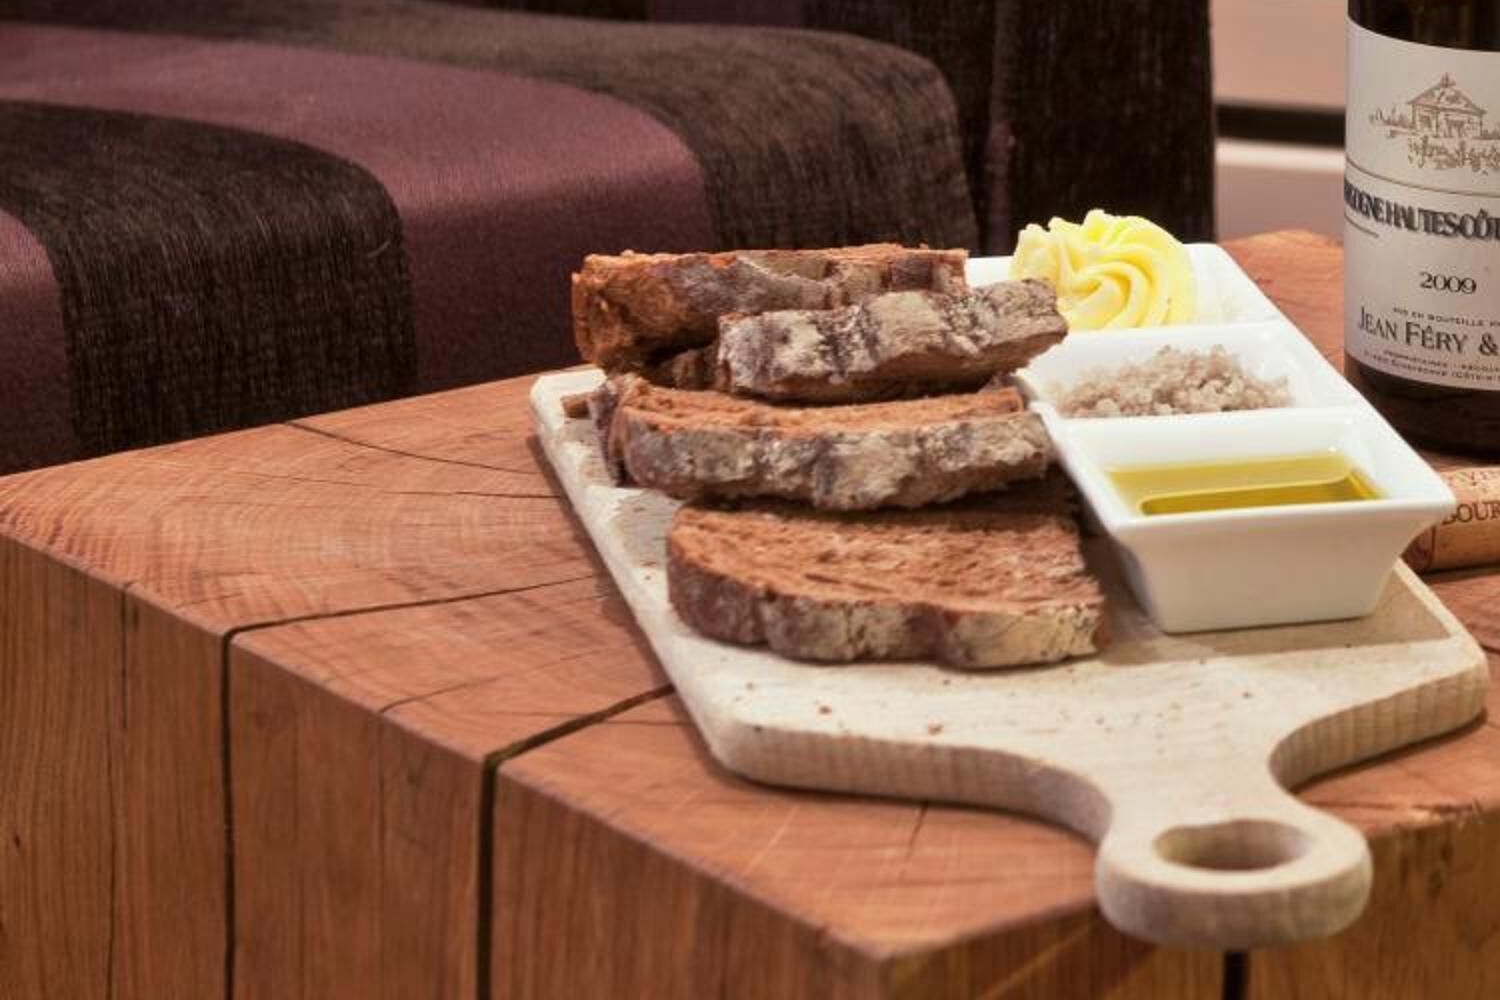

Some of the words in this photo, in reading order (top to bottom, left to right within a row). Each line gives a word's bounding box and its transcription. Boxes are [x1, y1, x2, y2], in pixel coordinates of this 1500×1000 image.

[1419, 271, 1477, 295] 2009
[1359, 305, 1397, 341] JEAN
[1479, 333, 1498, 357] &
